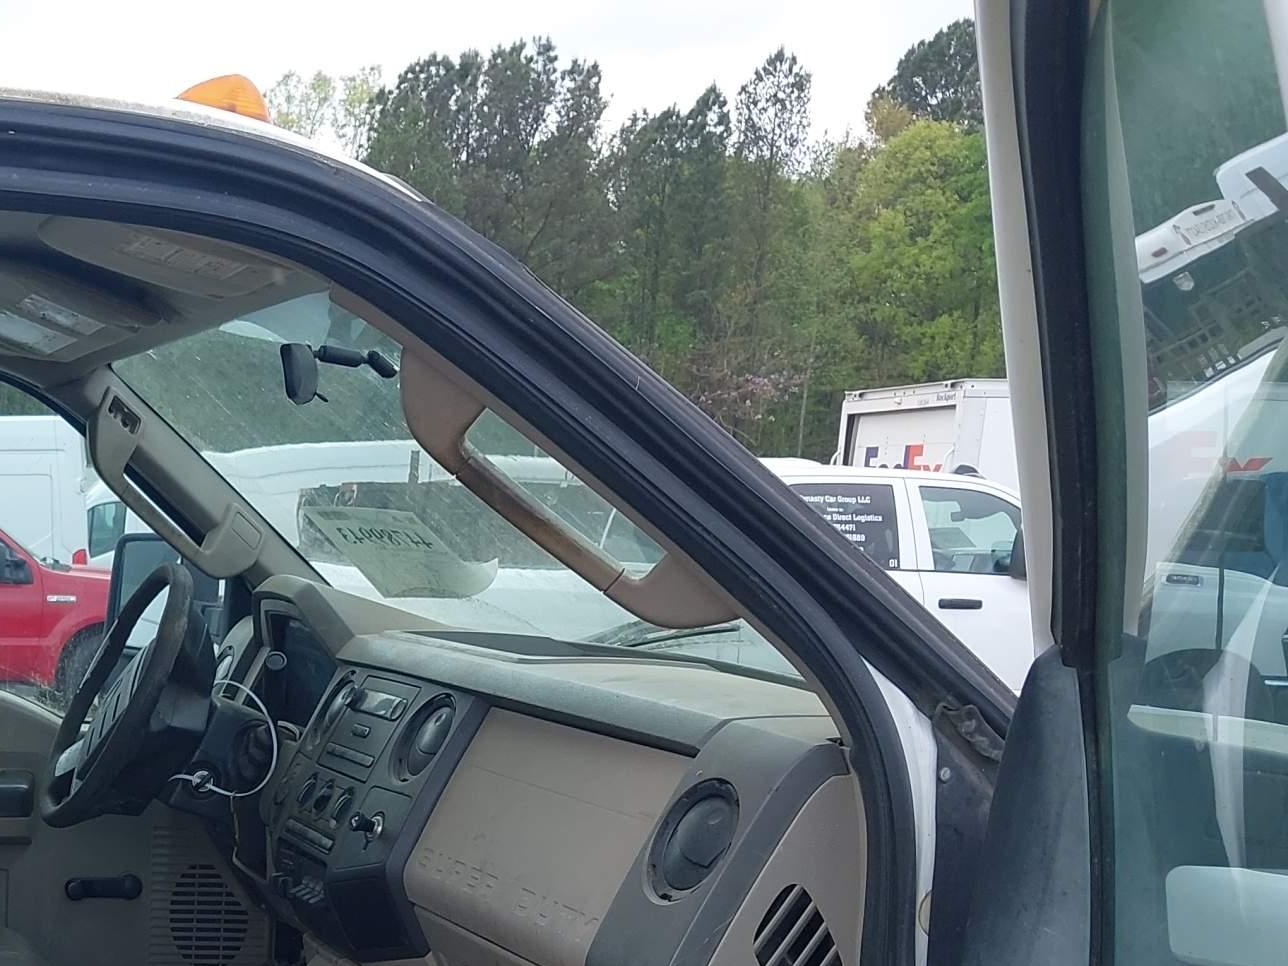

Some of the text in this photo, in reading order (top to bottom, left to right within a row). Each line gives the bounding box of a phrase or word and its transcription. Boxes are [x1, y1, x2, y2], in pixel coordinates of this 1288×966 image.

[825, 495, 836, 503] Car
[837, 495, 857, 504] Group
[857, 495, 871, 504] LLC
[832, 513, 852, 521] Direct
[852, 513, 883, 523] Logistics
